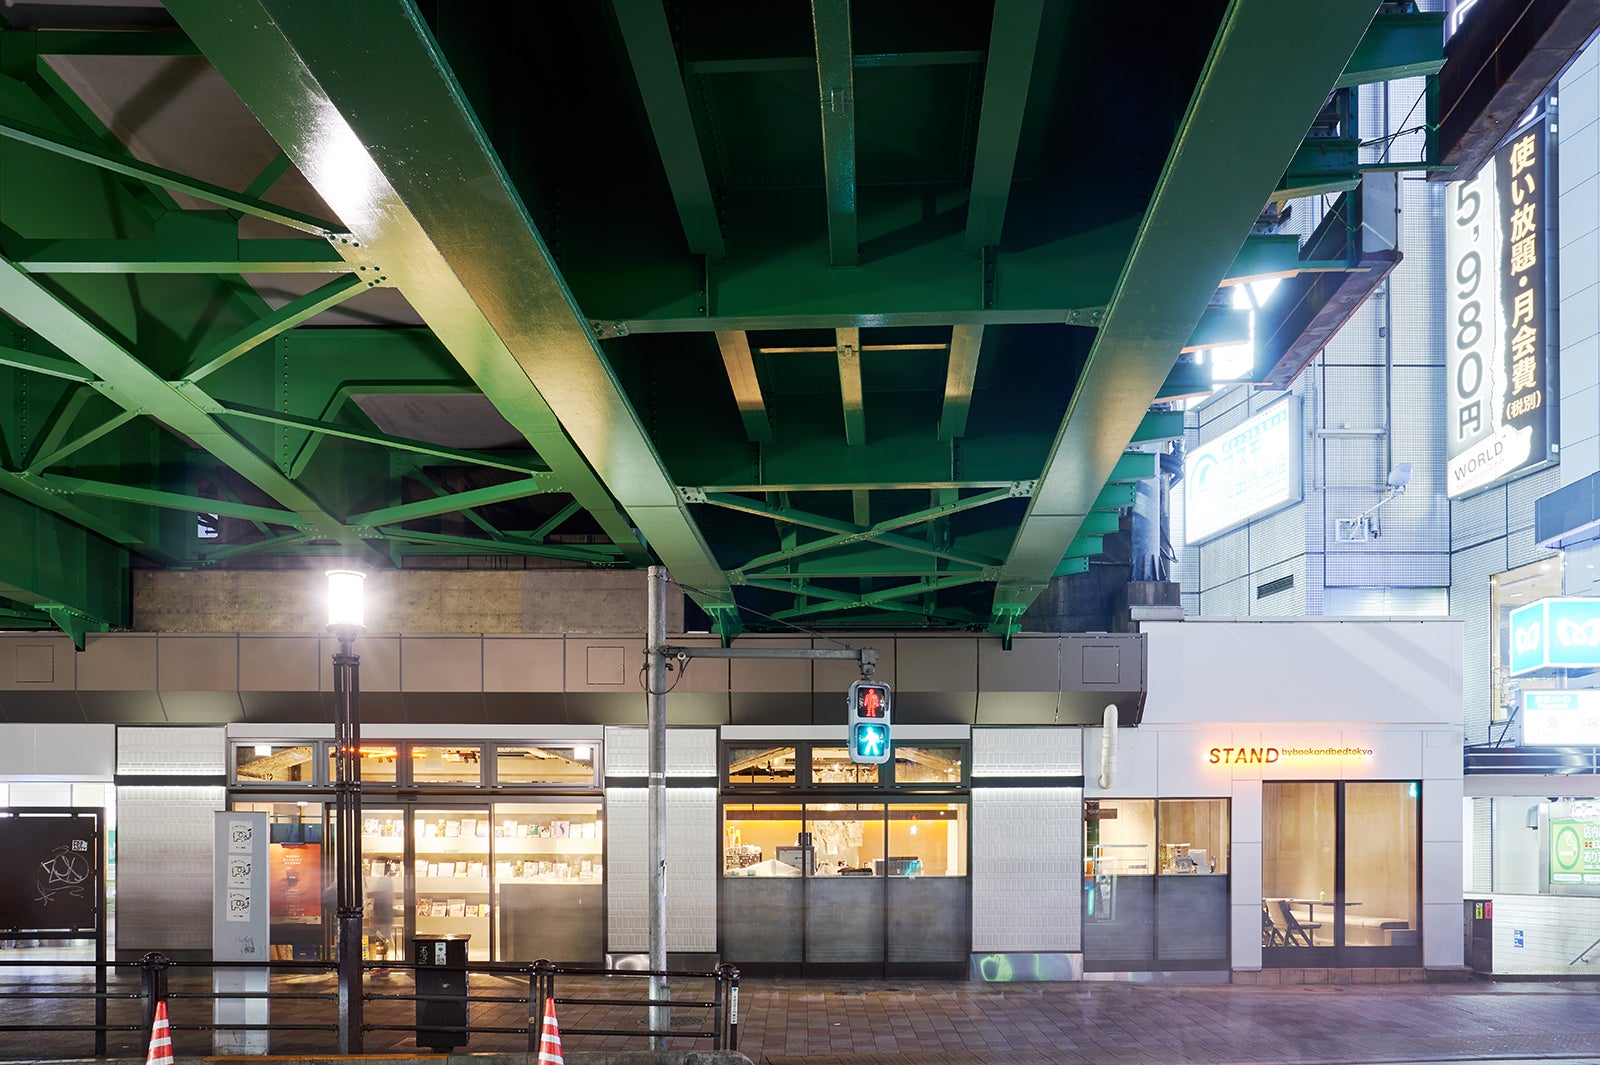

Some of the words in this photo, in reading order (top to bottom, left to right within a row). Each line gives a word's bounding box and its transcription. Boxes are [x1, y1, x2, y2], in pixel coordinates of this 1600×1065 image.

[1456, 174, 1483, 440] 5,980円
[1509, 133, 1537, 396] 使い放題・月会費
[1209, 747, 1280, 764] STAND
[1281, 747, 1373, 757] bybookandbedtokyo
